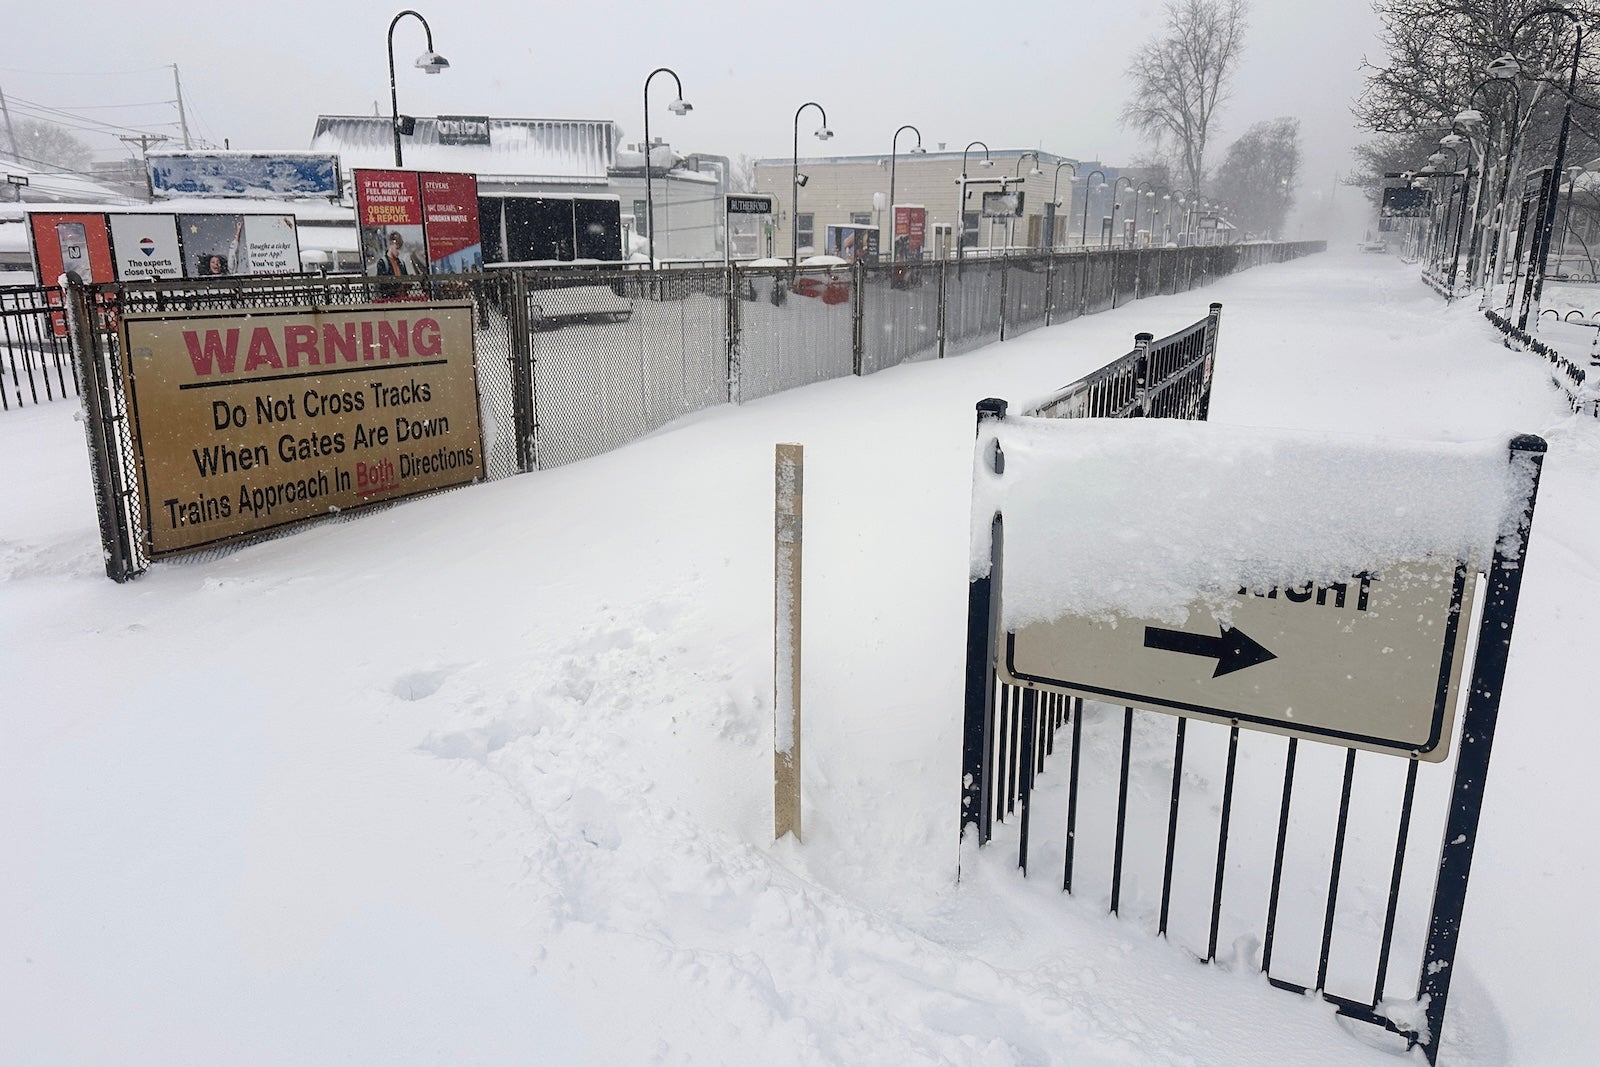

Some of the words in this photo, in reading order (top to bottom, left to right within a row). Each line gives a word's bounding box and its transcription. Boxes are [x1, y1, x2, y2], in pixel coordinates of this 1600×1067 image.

[437, 120, 488, 135] UNION
[368, 206, 406, 214] OBSERVE
[731, 200, 768, 211] RUTHERFORD
[369, 214, 376, 222] &
[377, 214, 410, 222] REPORT.
[268, 250, 283, 258] App?
[143, 259, 172, 267] experts
[274, 260, 286, 268] got
[182, 317, 443, 376] WARNING
[212, 400, 248, 431] Do
[255, 393, 297, 425] Not
[303, 389, 366, 418] Cross
[370, 378, 432, 408] Tracks
[192, 444, 270, 478] When
[278, 432, 346, 463] Gates
[353, 423, 389, 450] Are
[396, 416, 450, 443] Down
[164, 493, 233, 529] Trains
[238, 470, 329, 519] Approach
[335, 466, 351, 493] In
[356, 458, 397, 489] Both
[400, 447, 475, 479] Directions
[1237, 570, 1384, 612] GHT
